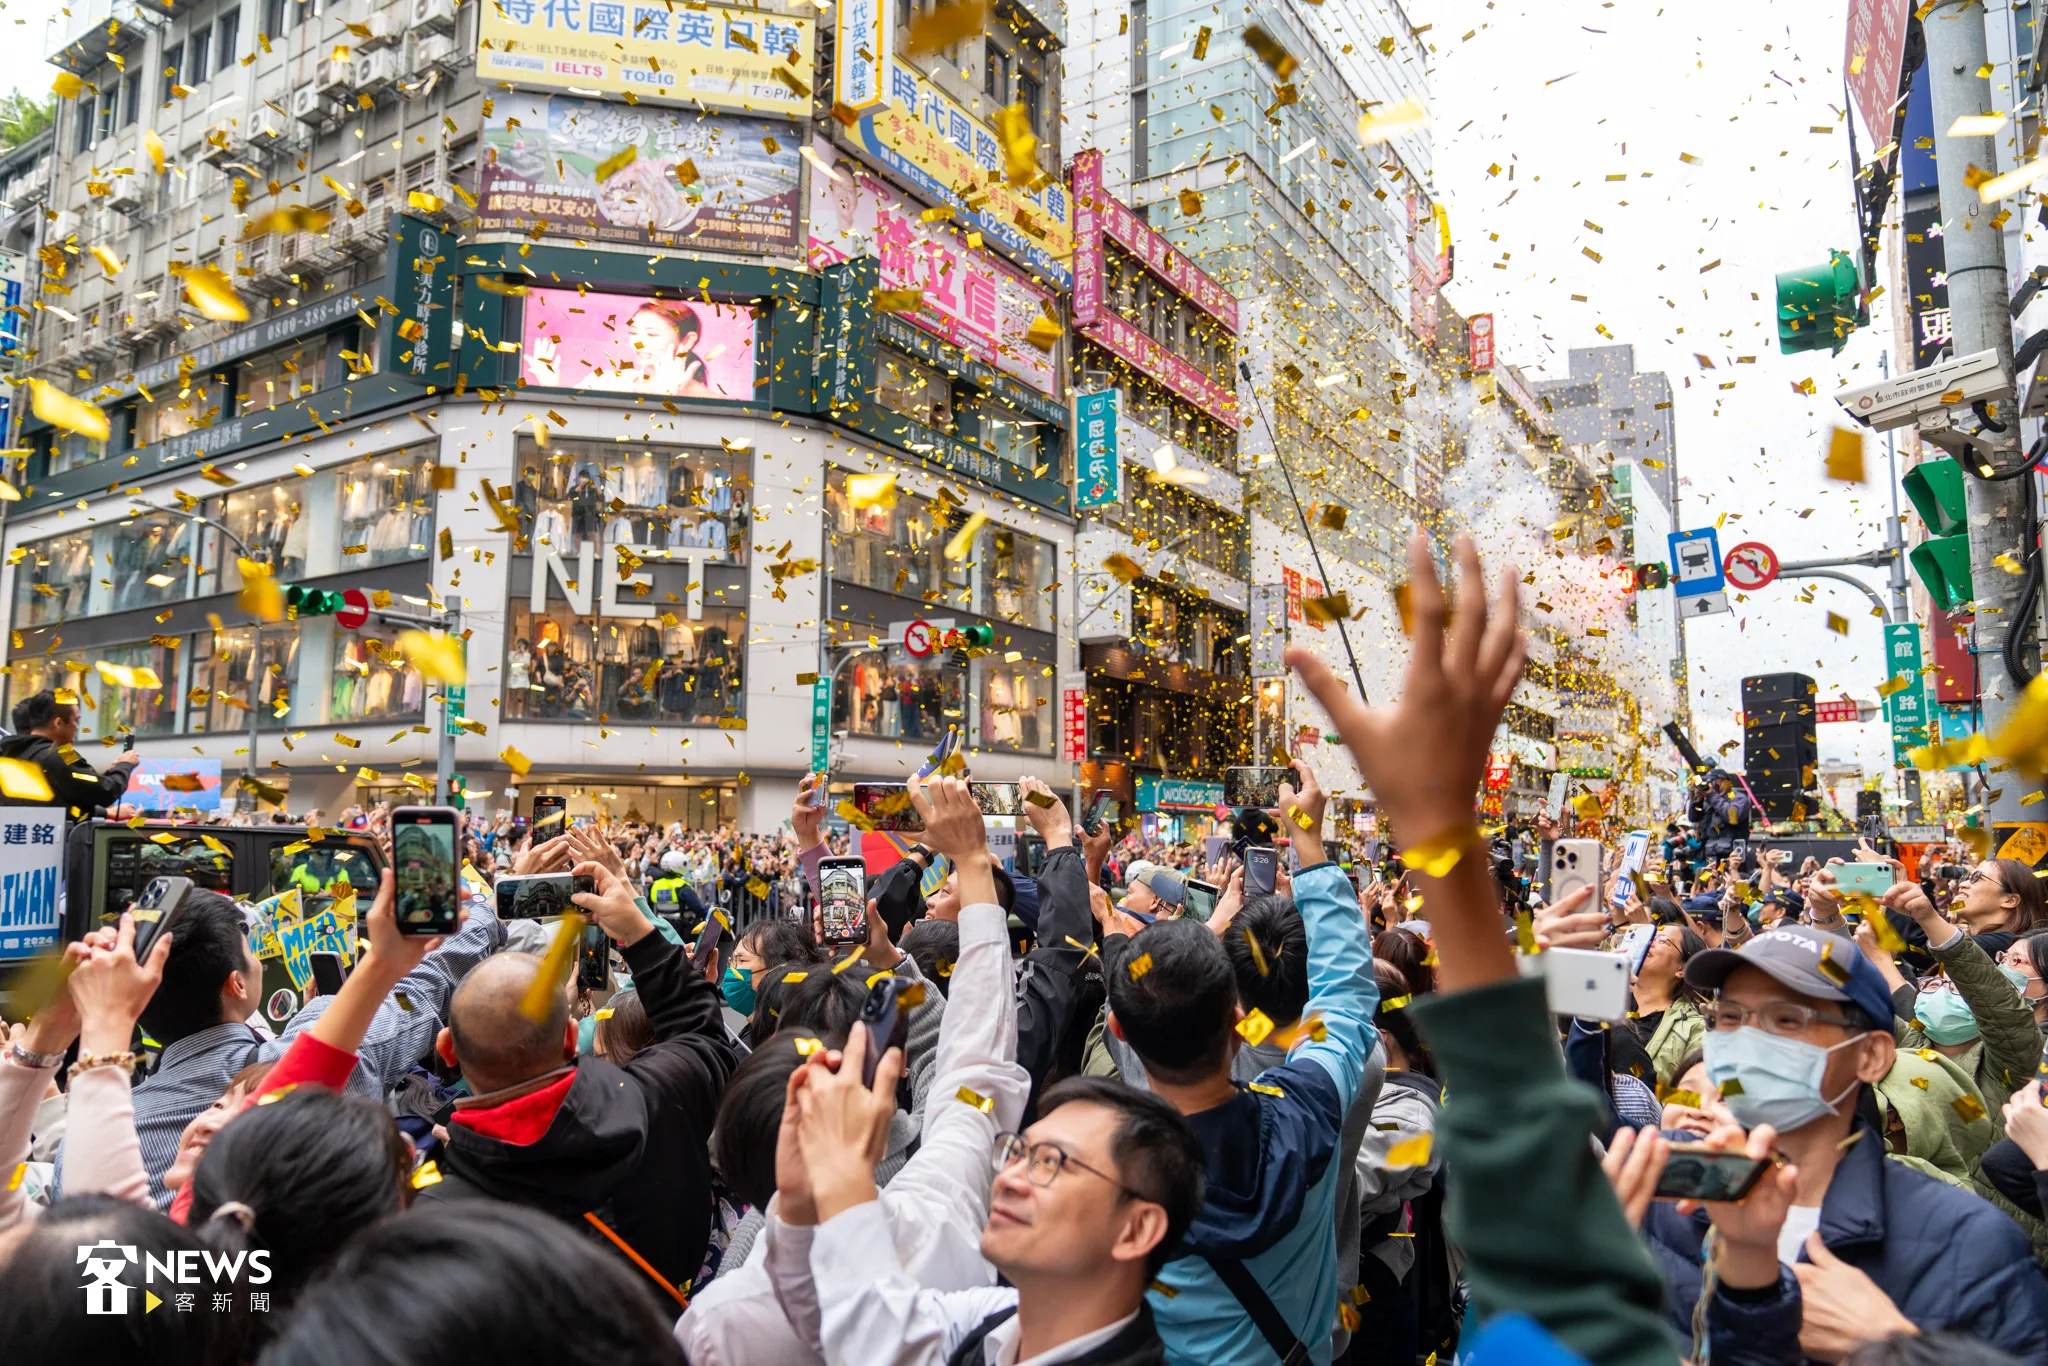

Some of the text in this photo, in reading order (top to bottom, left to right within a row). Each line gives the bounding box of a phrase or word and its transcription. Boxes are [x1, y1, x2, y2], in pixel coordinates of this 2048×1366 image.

[555, 61, 603, 79] IELTS
[620, 53, 678, 69] 多益特中心
[623, 69, 675, 87] TOEIC
[892, 64, 1067, 225] 時代國際日韓
[1876, 378, 1944, 404] 臺北市政府警察局
[1088, 418, 1106, 479] 屈臣氏
[530, 540, 726, 621] NET
[1894, 714, 1919, 723] Guan
[1162, 787, 1205, 802] watsons
[3, 823, 55, 845] 建銘
[0, 866, 57, 927] IWAN
[23, 935, 54, 947] 2024
